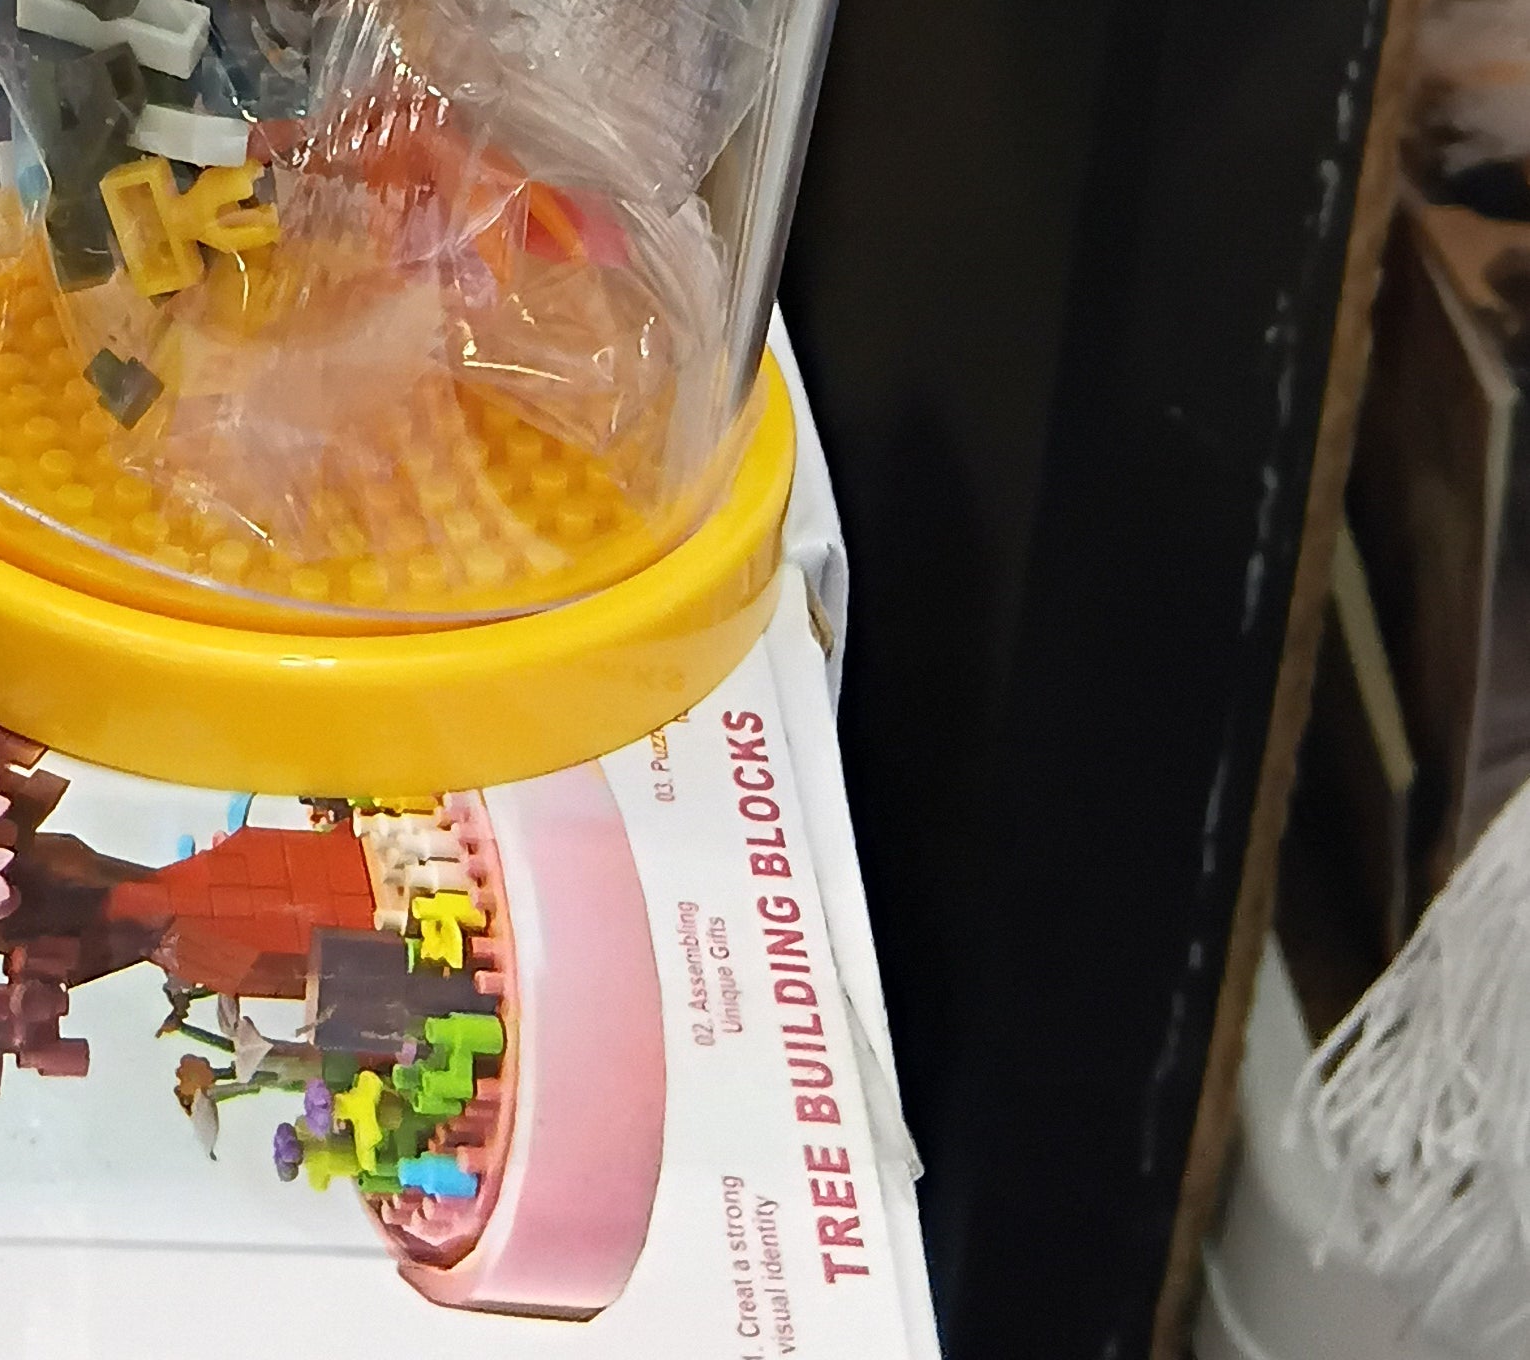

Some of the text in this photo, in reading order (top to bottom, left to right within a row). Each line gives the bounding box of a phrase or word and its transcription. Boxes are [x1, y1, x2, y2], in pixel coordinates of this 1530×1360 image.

[675, 901, 709, 1012] Assembling
[706, 916, 743, 1033] Unique Gifts
[721, 708, 870, 1285] TREE BUILDING BLOCKS
[721, 1175, 748, 1252] strong
[733, 1259, 751, 1272] a
[751, 1196, 796, 1355] visual identity
